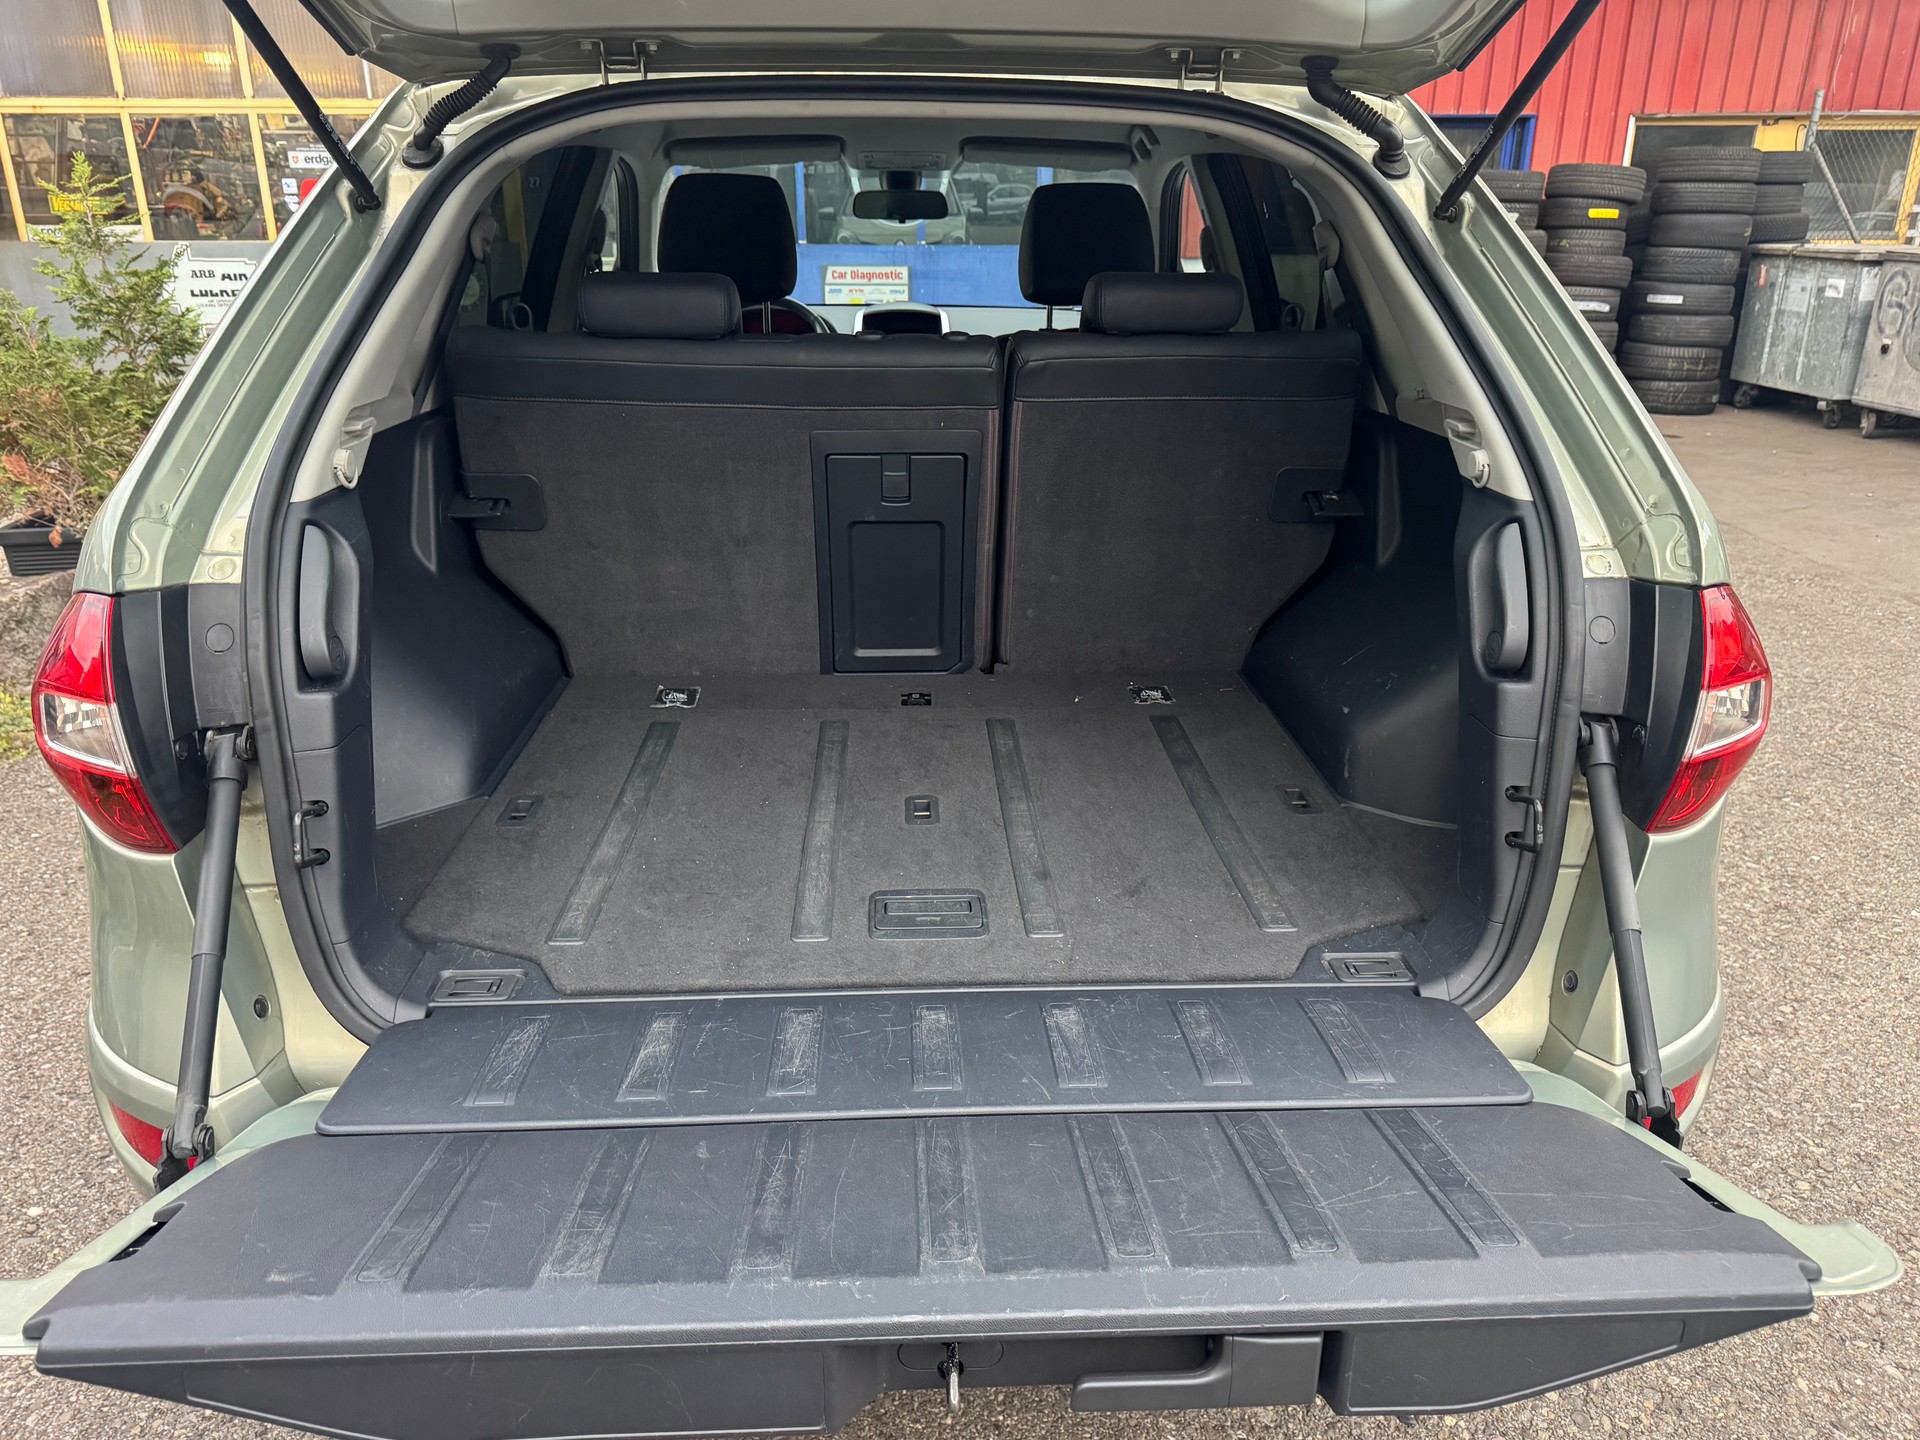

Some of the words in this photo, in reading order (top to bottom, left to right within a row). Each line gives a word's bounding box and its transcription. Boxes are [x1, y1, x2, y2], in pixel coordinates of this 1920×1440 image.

[190, 269, 216, 279] ARB
[831, 269, 848, 280] Car
[850, 269, 903, 283] Diagnostic
